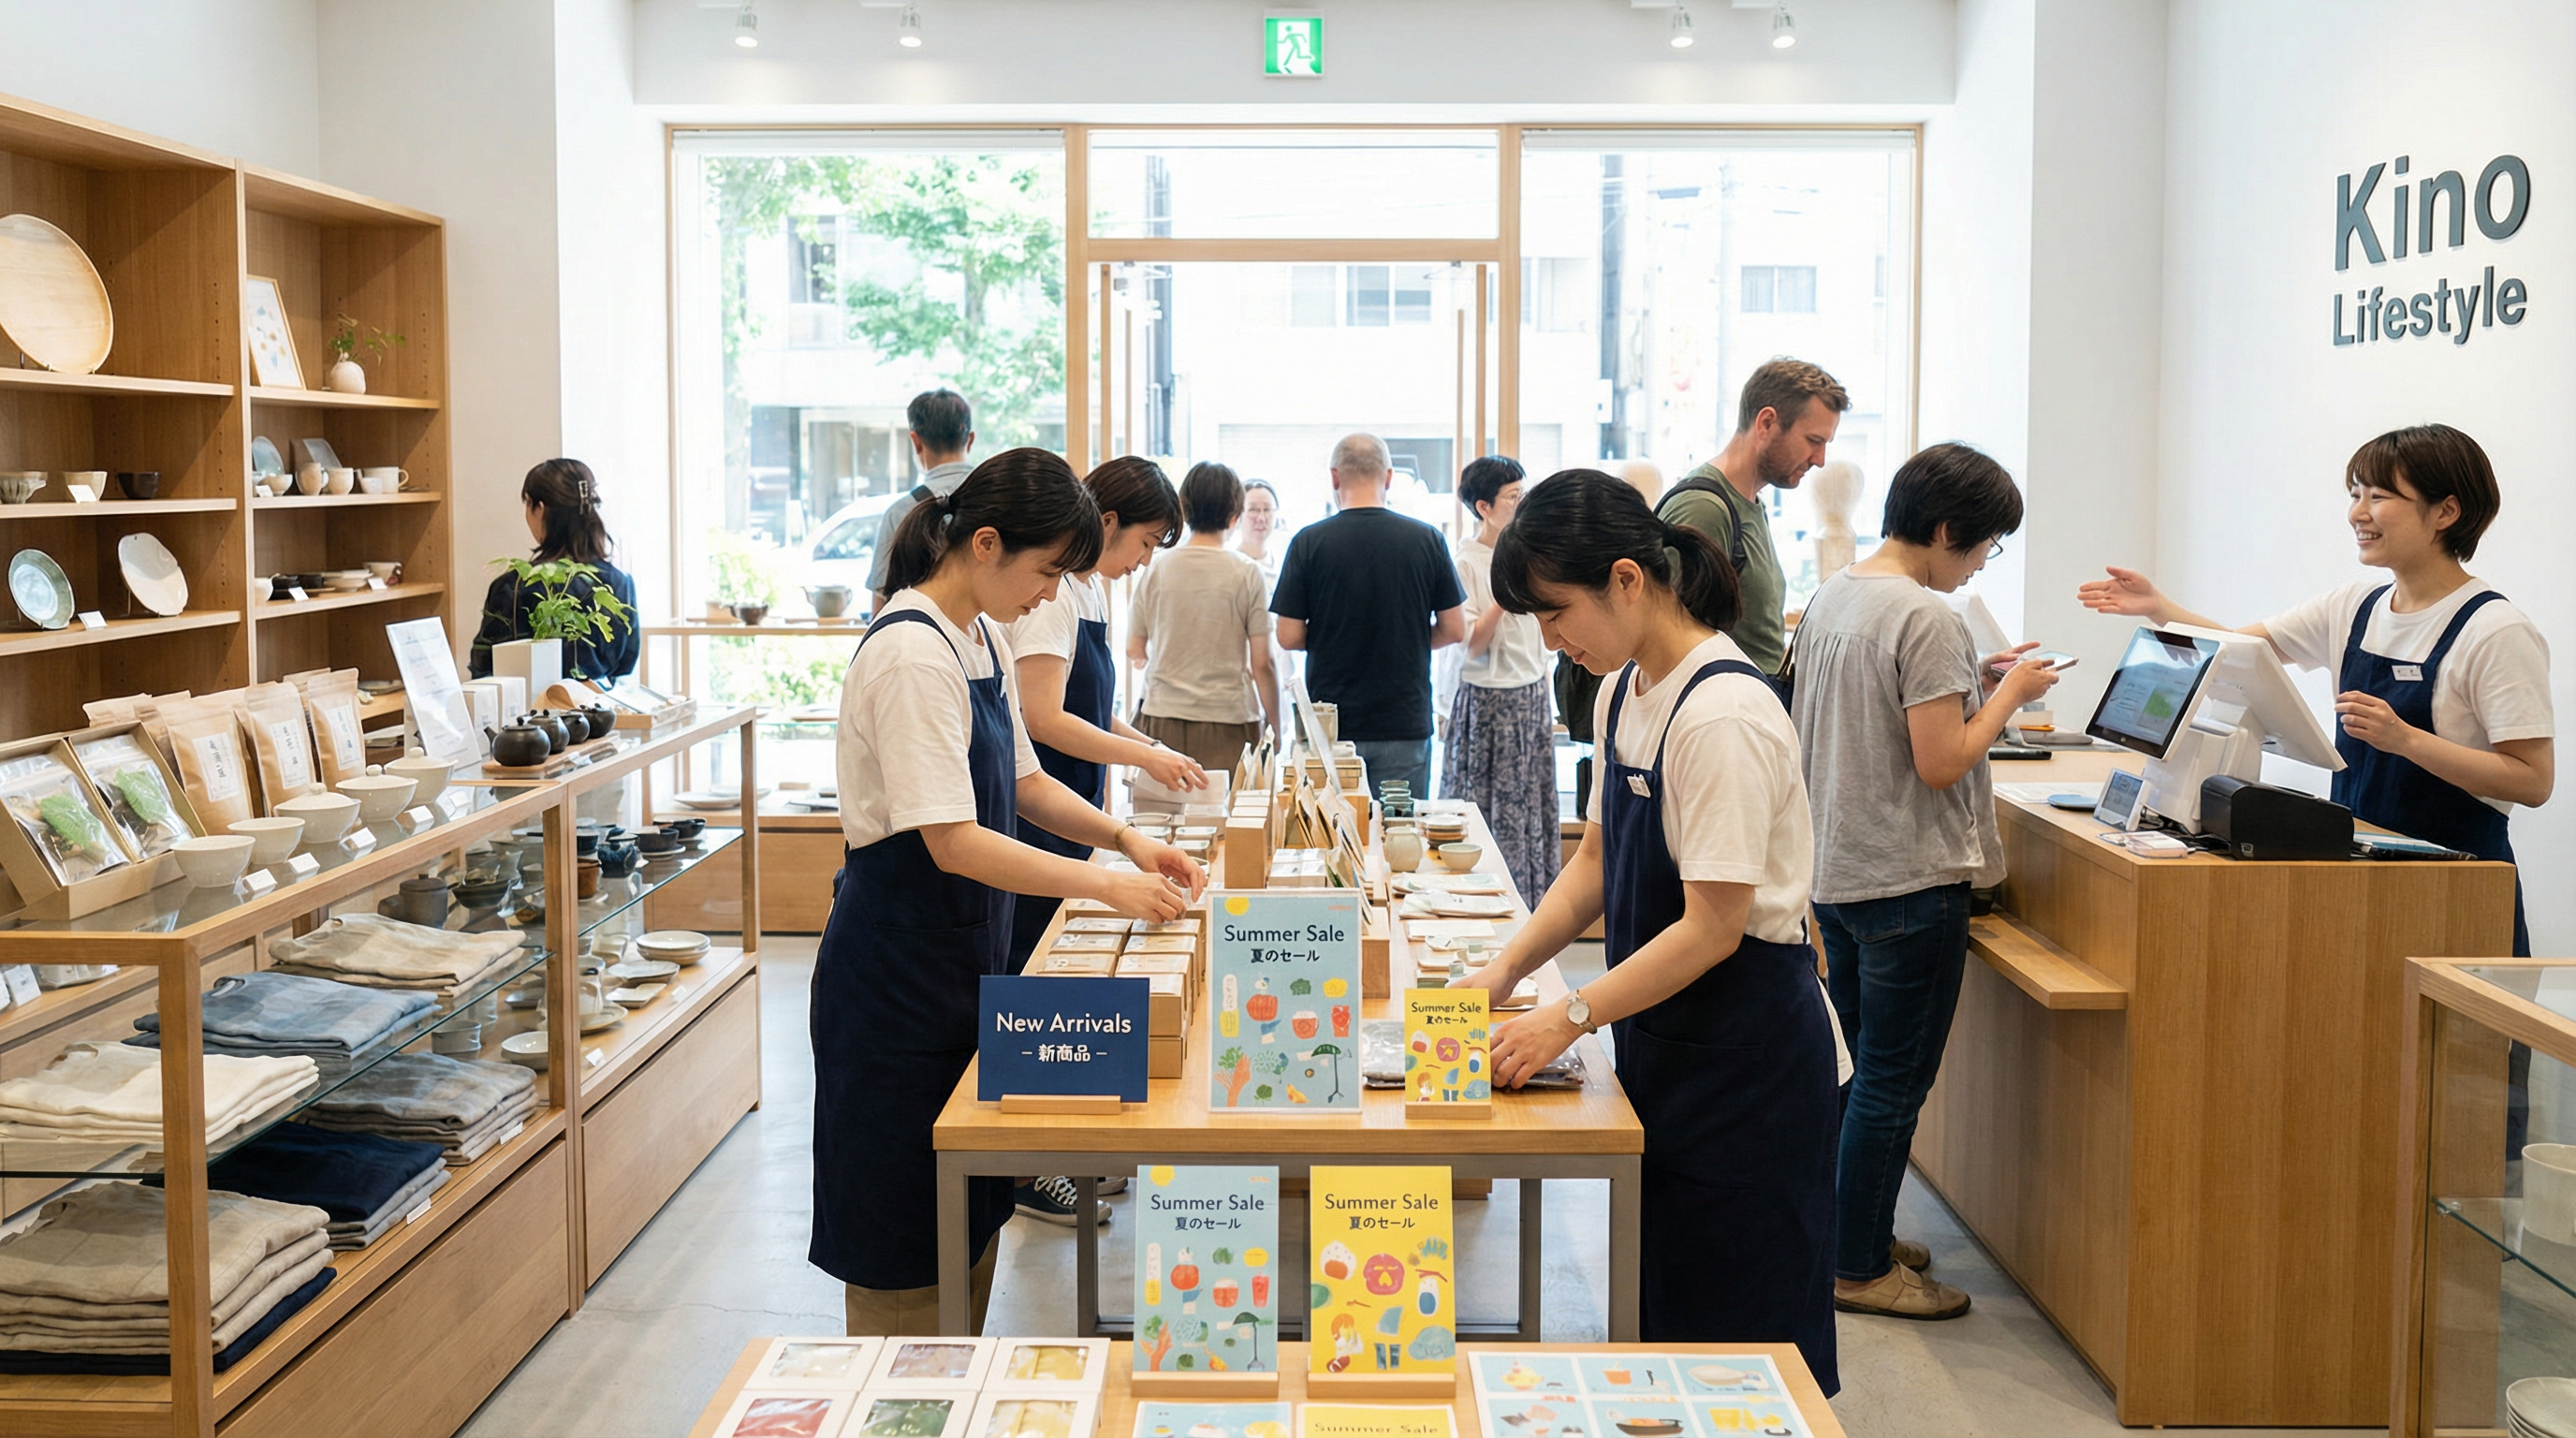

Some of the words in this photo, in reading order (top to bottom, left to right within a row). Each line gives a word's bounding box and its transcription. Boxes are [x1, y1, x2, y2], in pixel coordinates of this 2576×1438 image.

[2334, 154, 2531, 271] Kino
[2334, 266, 2527, 345] Lifestyle
[1224, 924, 1301, 942] Summer
[1307, 924, 1345, 942] Sale
[1251, 947, 1321, 963] 夏のセール
[1412, 1002, 1456, 1013] Summer
[1458, 1002, 1482, 1014] Sale
[996, 1012, 1045, 1033] New
[1049, 1012, 1132, 1034] Arrivals
[1150, 1194, 1223, 1211] Summer
[1228, 1194, 1265, 1211] Sale
[1325, 1193, 1398, 1210] Summer
[1402, 1193, 1439, 1210] Sale
[1175, 1216, 1242, 1231] 夏のセール
[1349, 1216, 1415, 1230] 夏のセール
[1314, 1422, 1392, 1433] Summer
[1400, 1424, 1439, 1434] Sale
